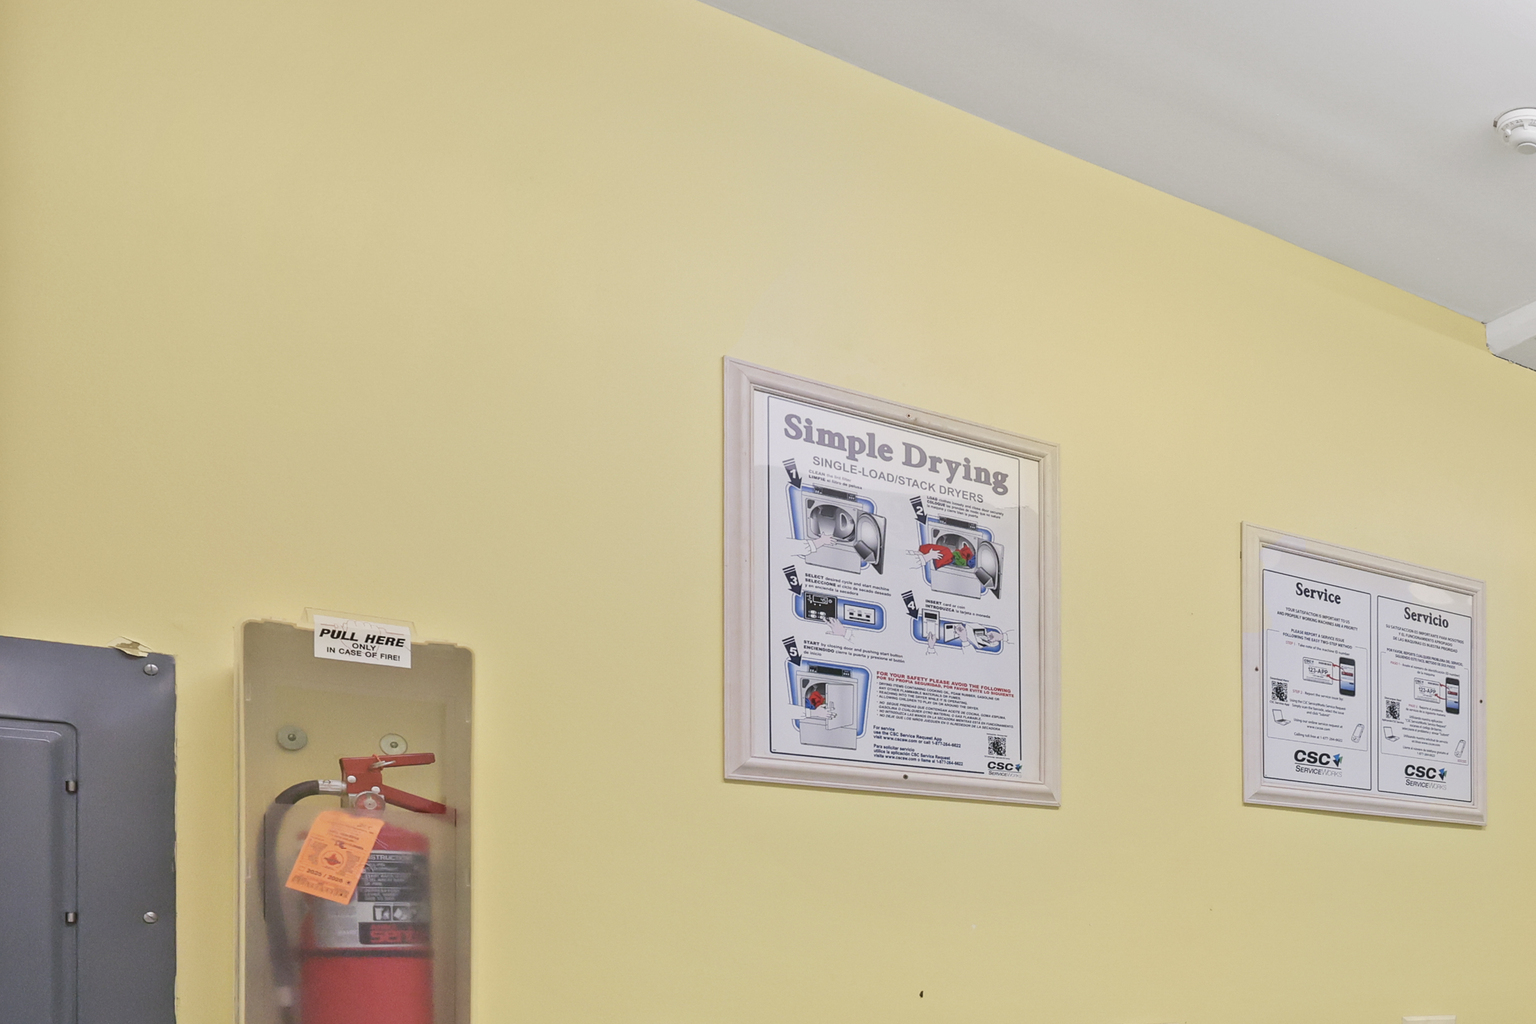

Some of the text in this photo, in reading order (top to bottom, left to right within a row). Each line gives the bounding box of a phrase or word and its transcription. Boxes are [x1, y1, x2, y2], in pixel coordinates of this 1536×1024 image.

[784, 413, 1009, 496] Simple Drying
[790, 469, 797, 479] 1
[812, 456, 984, 503] SINGLE-LOAD/STACK DRYERS
[916, 506, 924, 516] 2
[789, 575, 798, 586] 3
[1295, 582, 1341, 605] Service
[907, 601, 915, 610] 4
[1404, 606, 1449, 629] Servicio
[319, 628, 406, 648] PULL HERE
[351, 642, 377, 651] ONLY
[789, 647, 798, 657] 5
[338, 648, 362, 657] CASE
[380, 653, 401, 661] FIRE!
[981, 685, 1011, 694] FOLLOWING
[1294, 749, 1331, 766] CSC
[987, 761, 1014, 772] CSC
[1404, 764, 1437, 779] CSC
